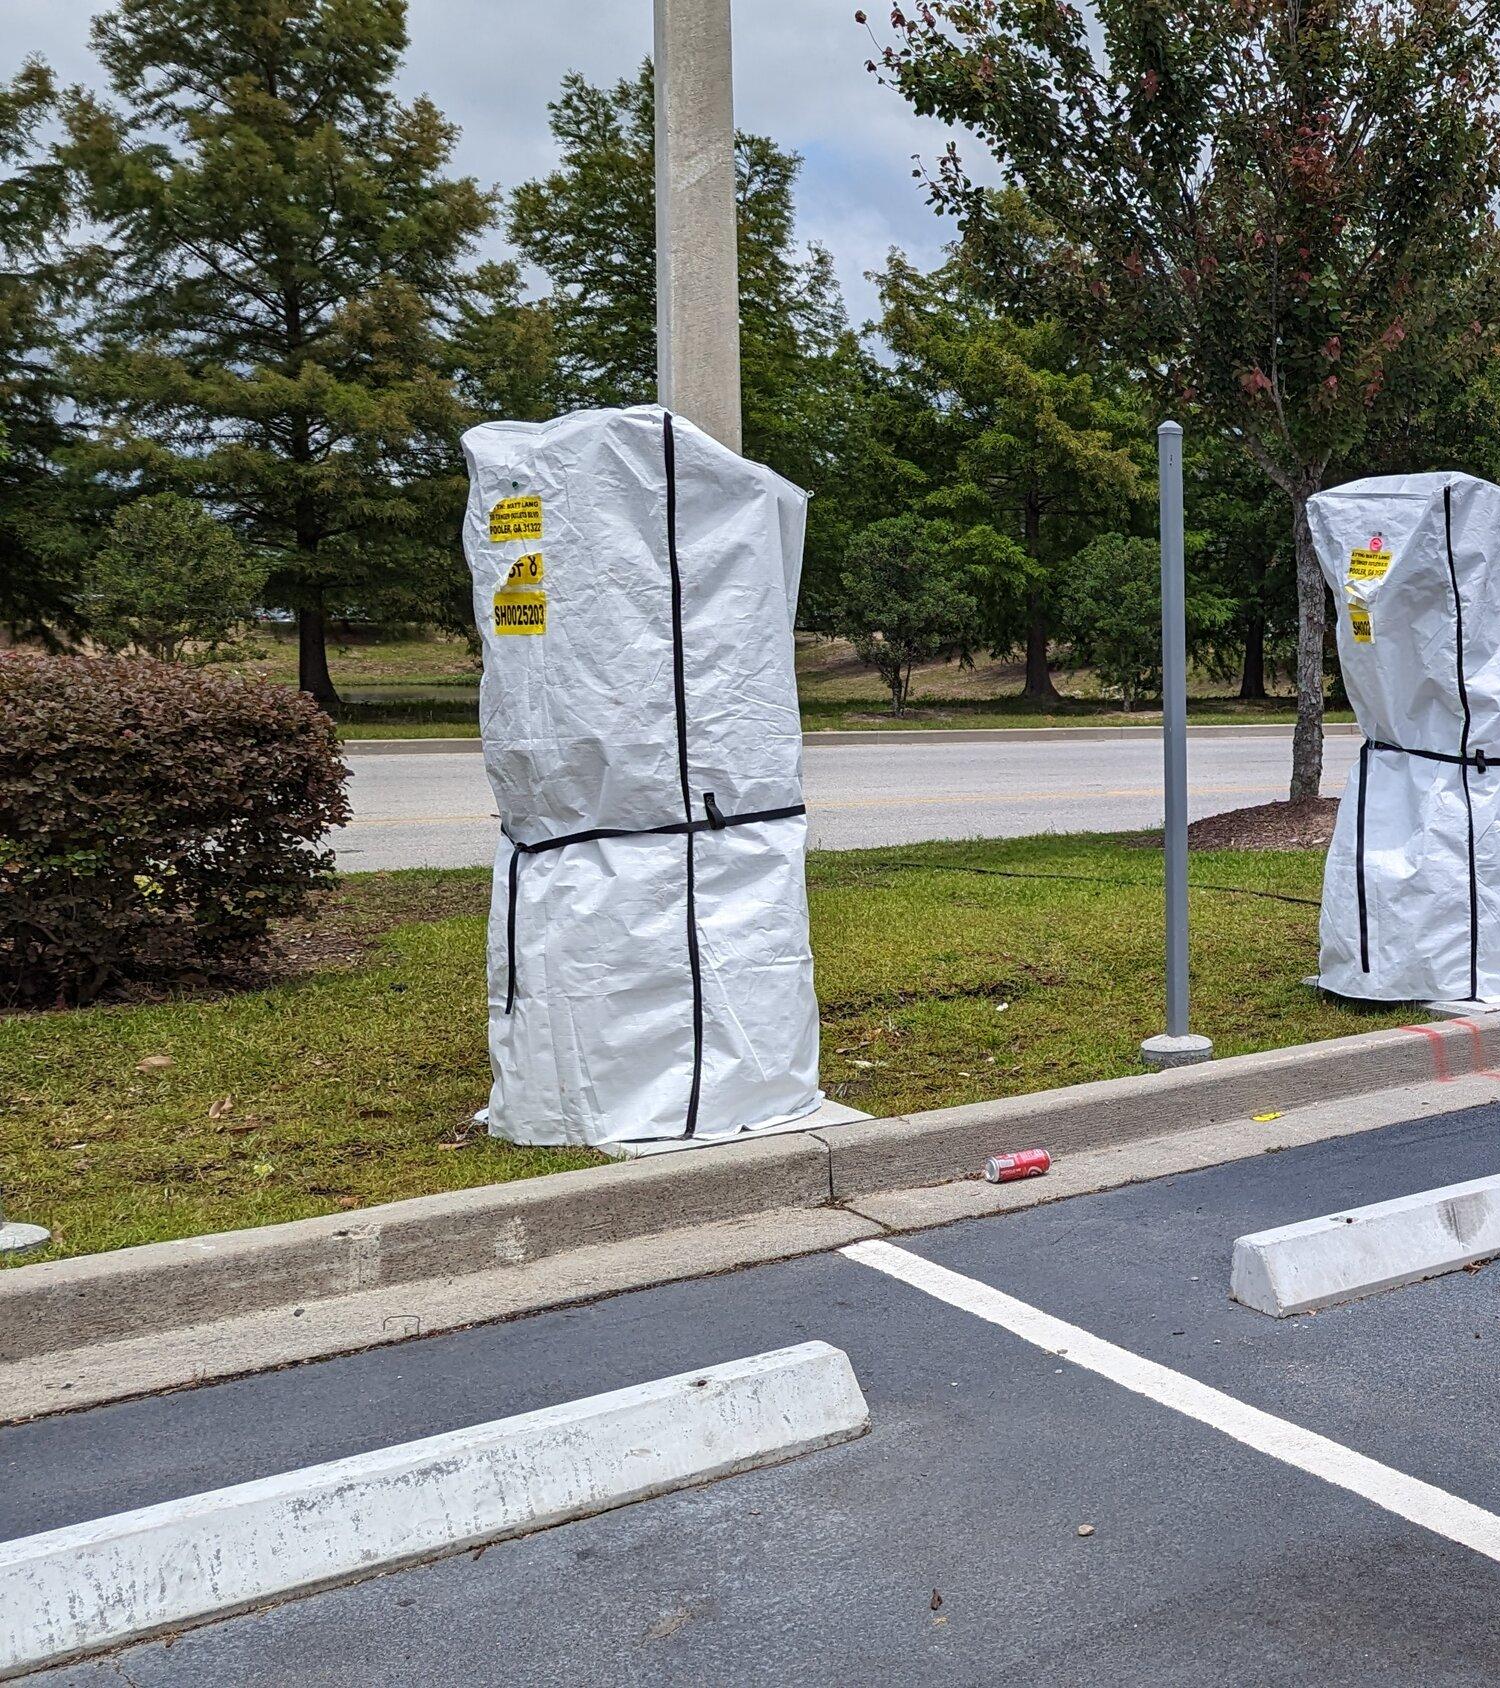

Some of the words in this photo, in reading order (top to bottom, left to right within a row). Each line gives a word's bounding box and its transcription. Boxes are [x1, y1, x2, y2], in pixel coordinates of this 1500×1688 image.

[513, 524, 522, 533] GA
[523, 523, 541, 533] 31322
[495, 605, 545, 626] SH0025203
